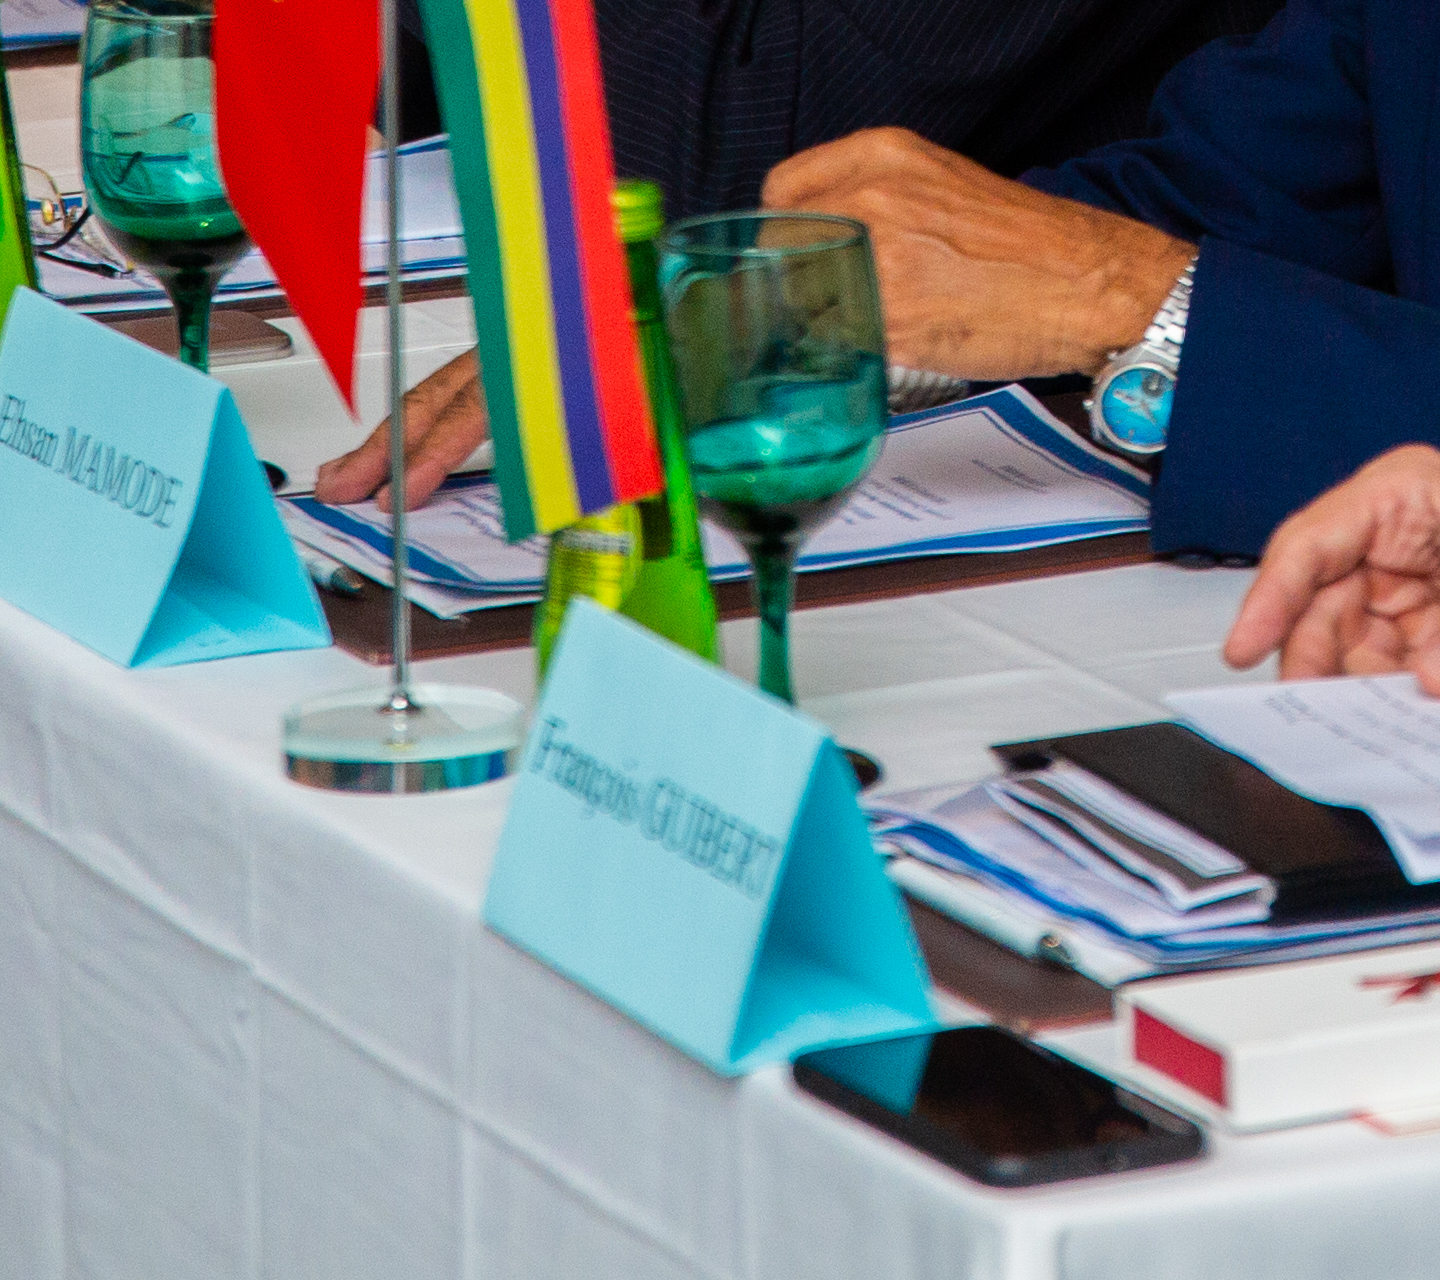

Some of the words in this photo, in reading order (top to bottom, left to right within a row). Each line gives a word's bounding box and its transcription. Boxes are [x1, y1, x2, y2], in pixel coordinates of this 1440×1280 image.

[55, 426, 183, 528] MAMODE
[529, 715, 640, 826] François
[638, 777, 781, 900] GUIBERT
